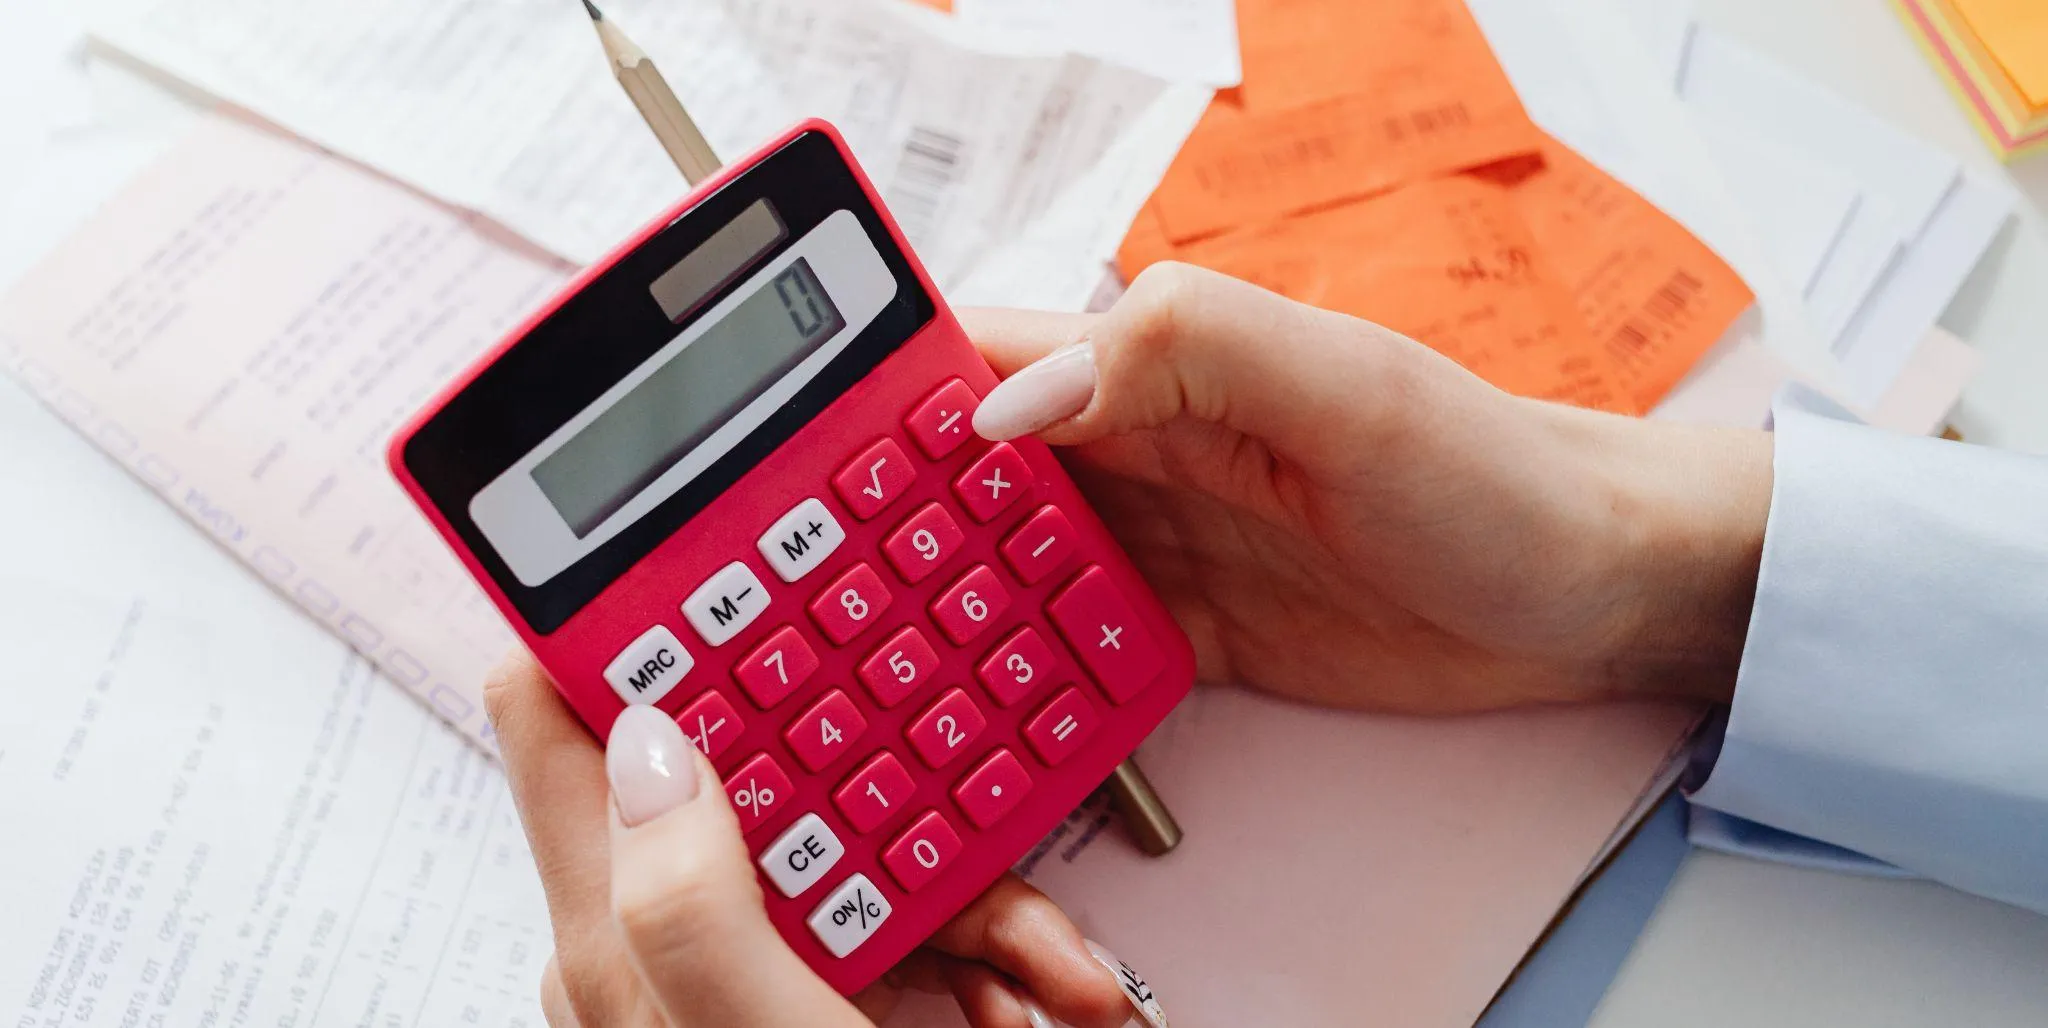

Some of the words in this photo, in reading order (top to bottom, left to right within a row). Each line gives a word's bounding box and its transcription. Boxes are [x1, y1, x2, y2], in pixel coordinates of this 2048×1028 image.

[779, 519, 826, 563] M+
[911, 527, 940, 561] 9
[708, 586, 753, 628] M-
[840, 587, 870, 622] 8
[960, 589, 989, 623] 6
[627, 647, 676, 695] MRC
[762, 649, 790, 686] 7
[888, 649, 917, 685] 5
[1005, 652, 1034, 685] 3
[820, 716, 844, 747] 4
[935, 713, 967, 749] 2
[865, 780, 890, 809] 1
[786, 833, 827, 873] CE
[911, 838, 940, 870] 0
[830, 887, 882, 931] ON/C
